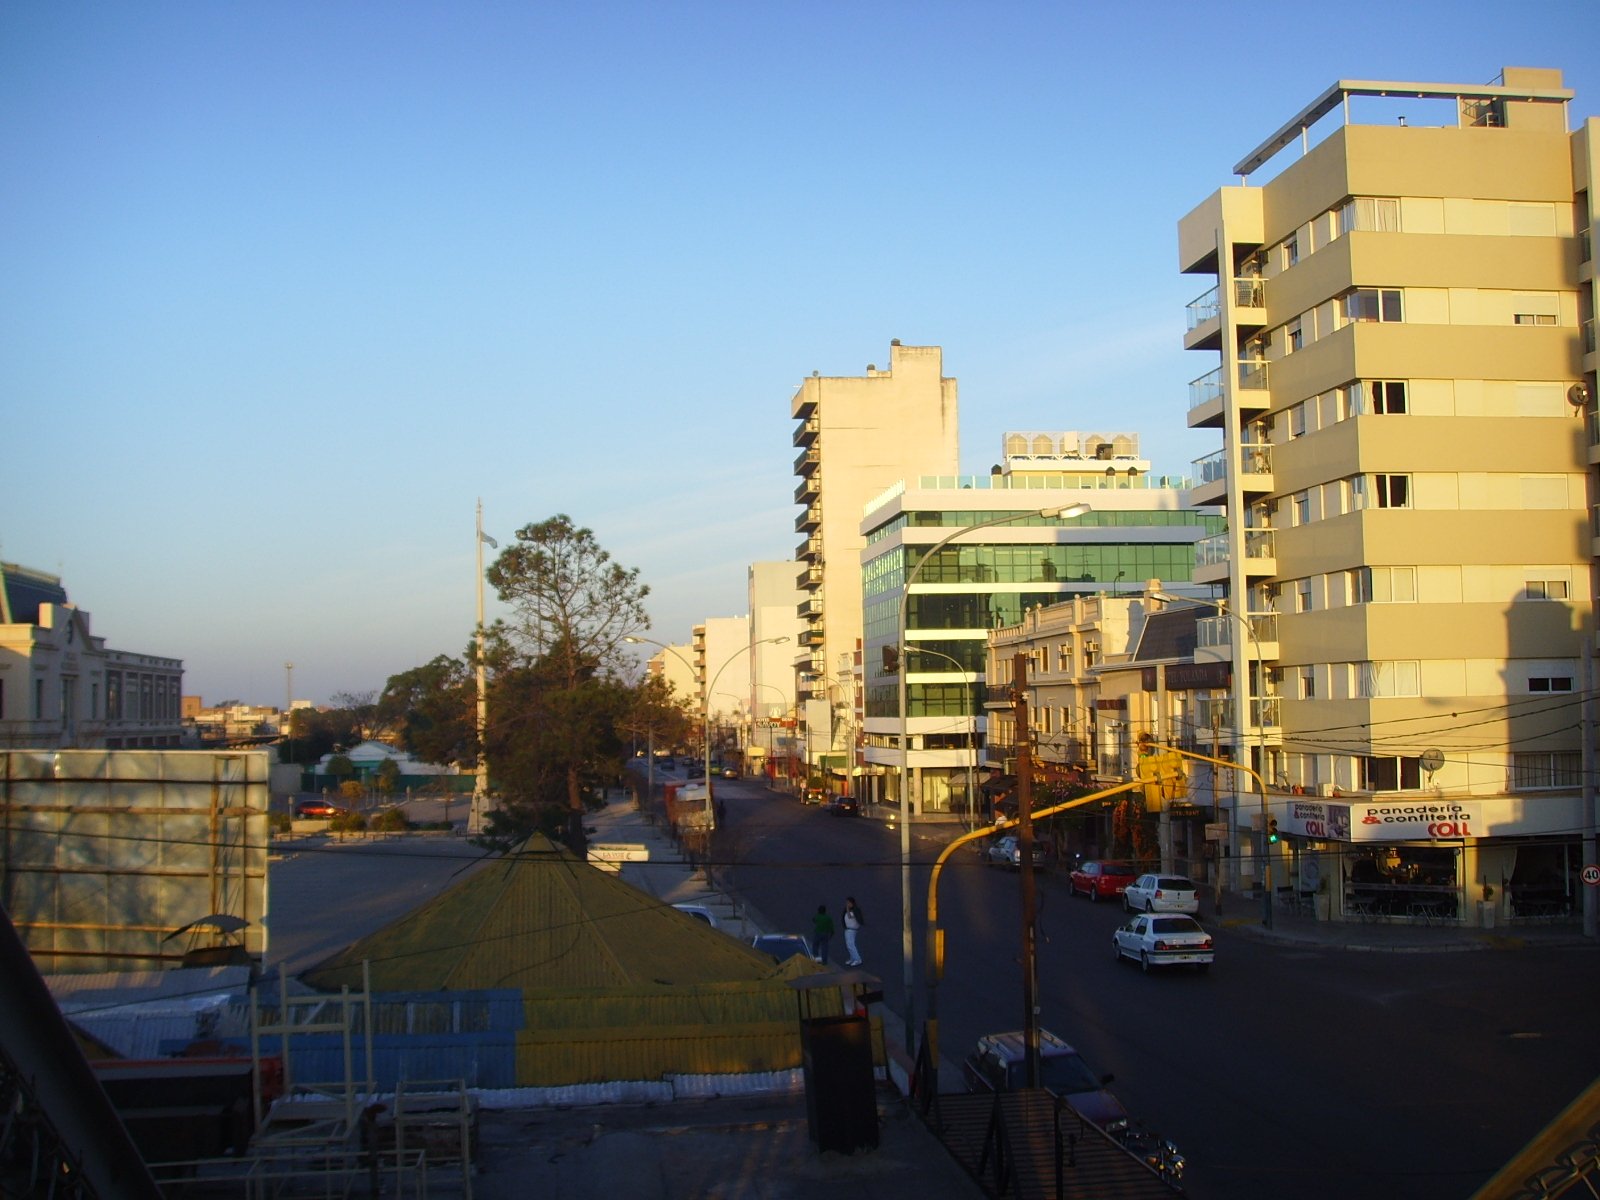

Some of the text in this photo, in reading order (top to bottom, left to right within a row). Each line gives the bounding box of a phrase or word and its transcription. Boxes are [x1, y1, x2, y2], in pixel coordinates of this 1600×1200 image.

[1367, 805, 1462, 817] panadería
[1362, 813, 1471, 825] & confitería
[1306, 821, 1325, 836] COLL
[1428, 822, 1471, 837] COLL
[1585, 870, 1599, 880] 40
